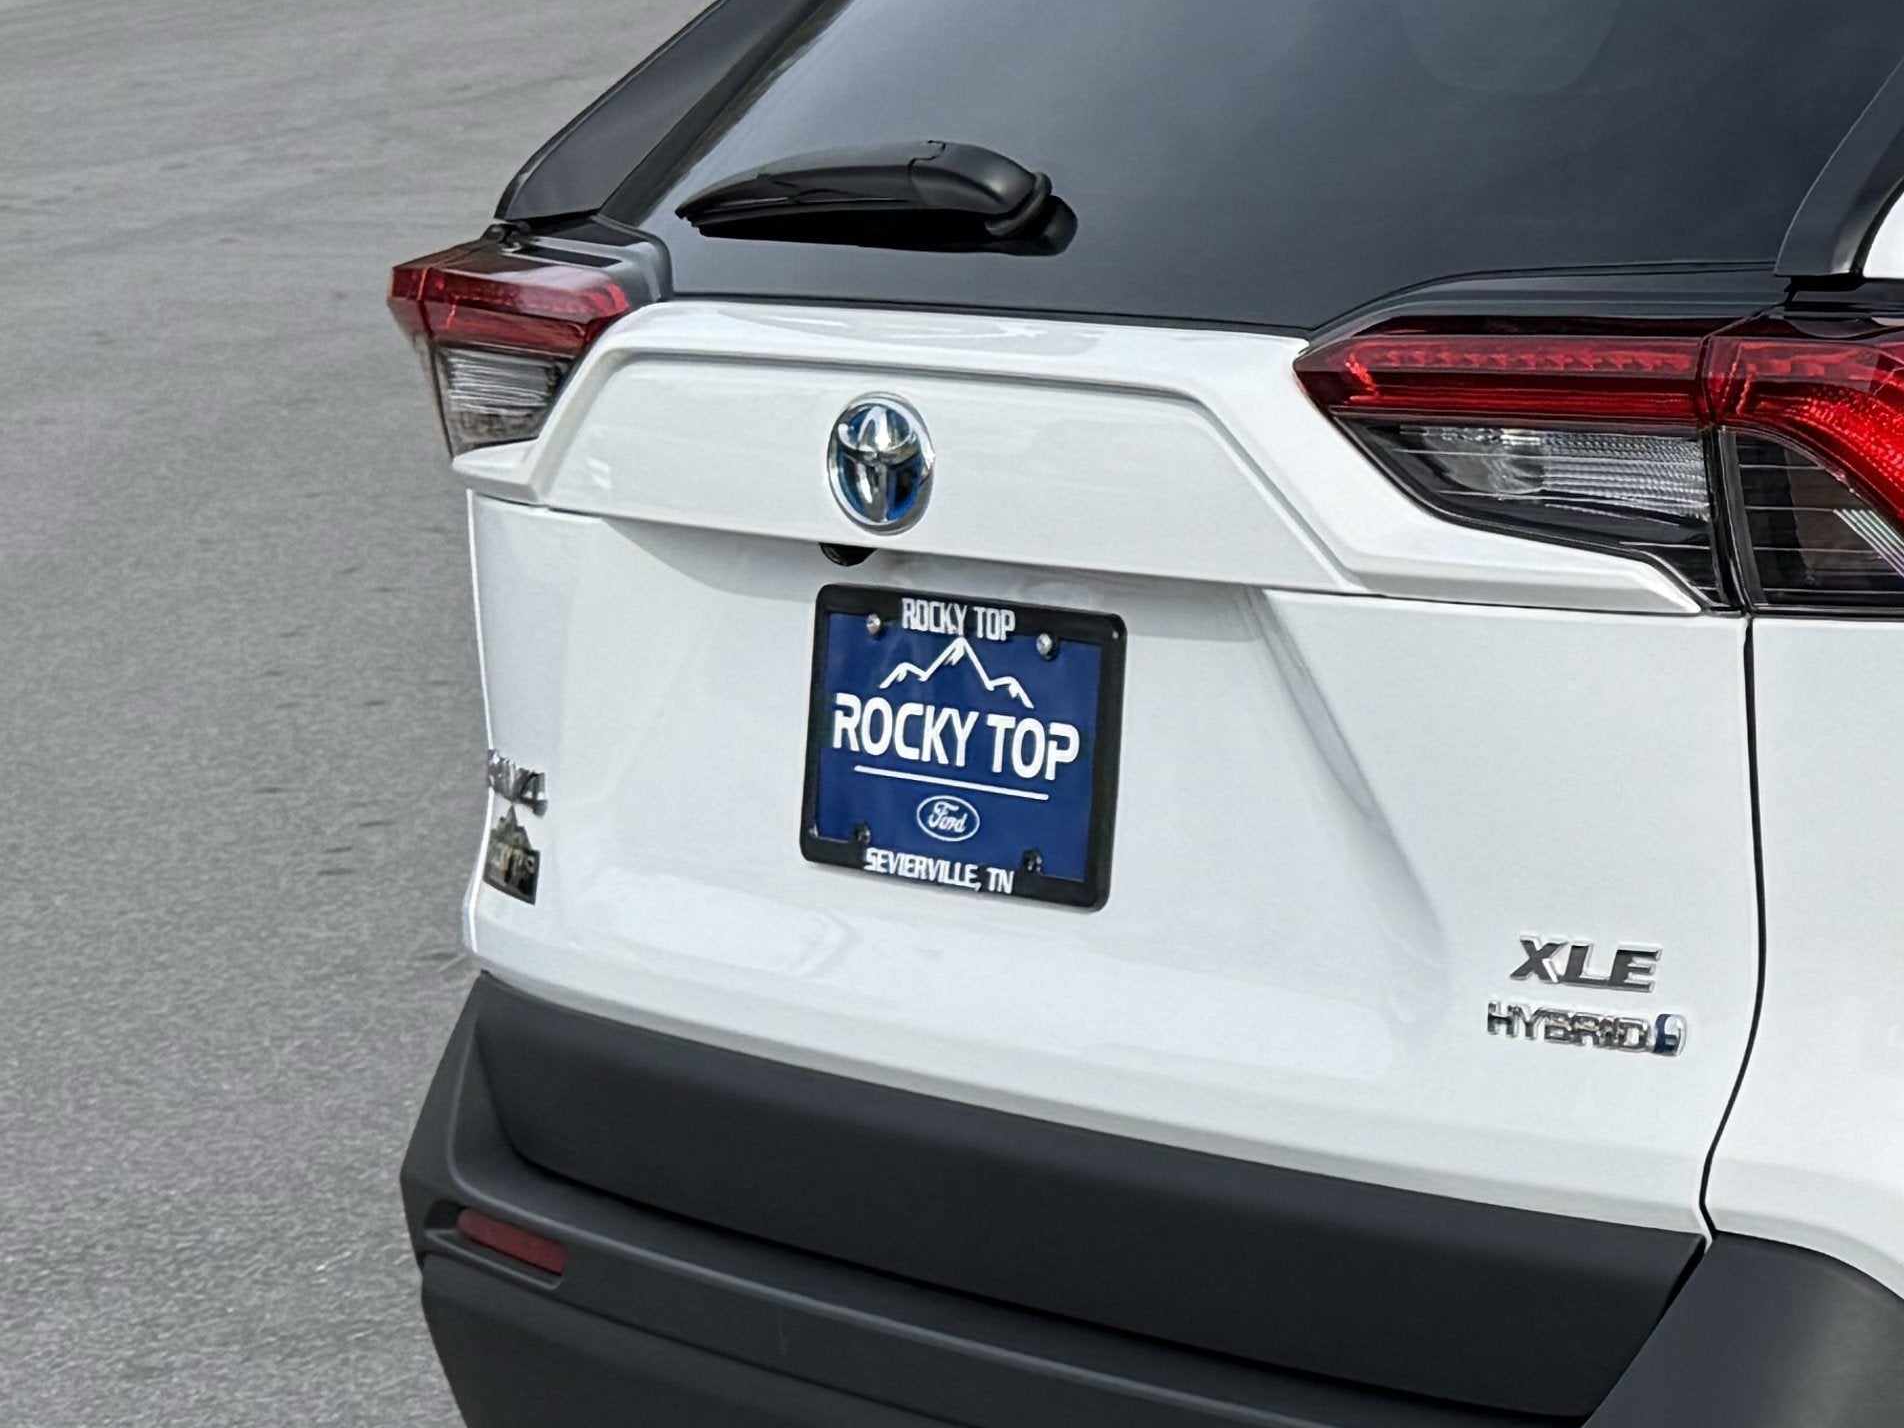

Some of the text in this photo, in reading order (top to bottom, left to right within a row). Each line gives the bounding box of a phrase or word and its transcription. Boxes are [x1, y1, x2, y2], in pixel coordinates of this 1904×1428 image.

[901, 597, 1016, 641] ROCKY TOP
[833, 692, 1080, 780] ROCKY TOP
[927, 802, 967, 834] Ford
[864, 847, 1014, 894] SEVIERVILLE, TN
[1510, 936, 1662, 993] XLE
